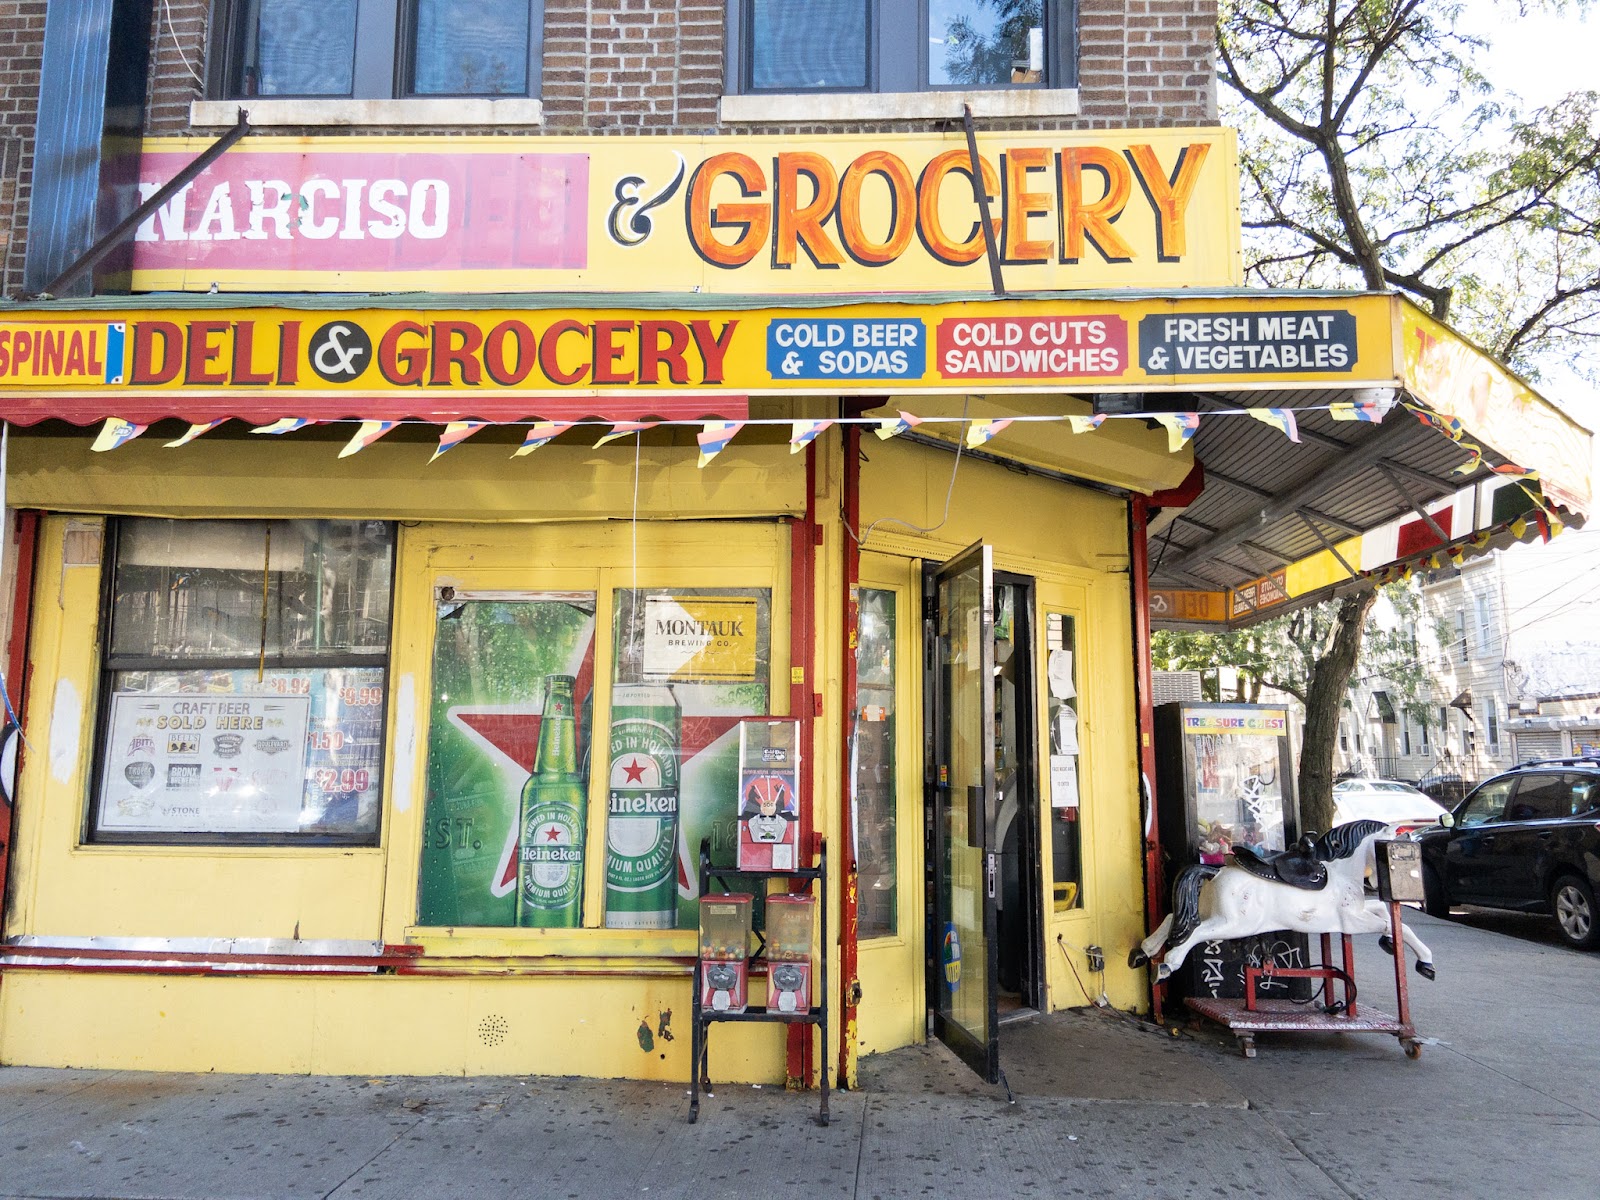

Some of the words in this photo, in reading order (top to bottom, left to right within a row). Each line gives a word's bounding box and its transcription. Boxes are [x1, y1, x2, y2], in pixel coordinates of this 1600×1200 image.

[134, 178, 450, 242] NARCISO
[607, 151, 686, 246] &
[685, 143, 1212, 270] GROCERY
[775, 323, 846, 348] COLD
[853, 323, 918, 348] BEER
[953, 322, 1022, 347] COLD
[1029, 320, 1107, 346] CUTS
[1164, 317, 1250, 343] FRESH
[1258, 315, 1335, 342] MEAT
[0, 329, 103, 377] SPINAL
[128, 320, 303, 386] DELI
[314, 325, 364, 375] &
[378, 319, 743, 387] GROCERY
[781, 350, 804, 375] &
[818, 349, 909, 375] SODAS
[945, 347, 1120, 374] SANDWICHES
[1147, 346, 1170, 371] &
[1176, 343, 1349, 370] VEGETABLES
[655, 619, 744, 637] MONTAUK
[172, 703, 217, 715] CRAFT
[217, 703, 250, 715] BEER
[338, 687, 382, 705] $9.99
[156, 715, 207, 730] SOLD
[215, 715, 264, 730] HERE
[552, 714, 562, 757] Heineken
[1185, 717, 1245, 728] TREASURE
[1247, 718, 1284, 729] CHEST
[625, 737, 637, 748] IN
[641, 737, 673, 778] HOLLAND
[171, 766, 198, 777] BRONX
[316, 768, 370, 792] $2.99
[171, 806, 200, 815] STONE
[526, 813, 546, 838] BREWED
[547, 812, 556, 820] IN
[557, 812, 579, 839] HOLLAND
[521, 846, 582, 861] Heineken
[636, 836, 672, 873] QUALITY
[524, 874, 551, 898] PREMIUM
[552, 875, 577, 898] QUALITY
